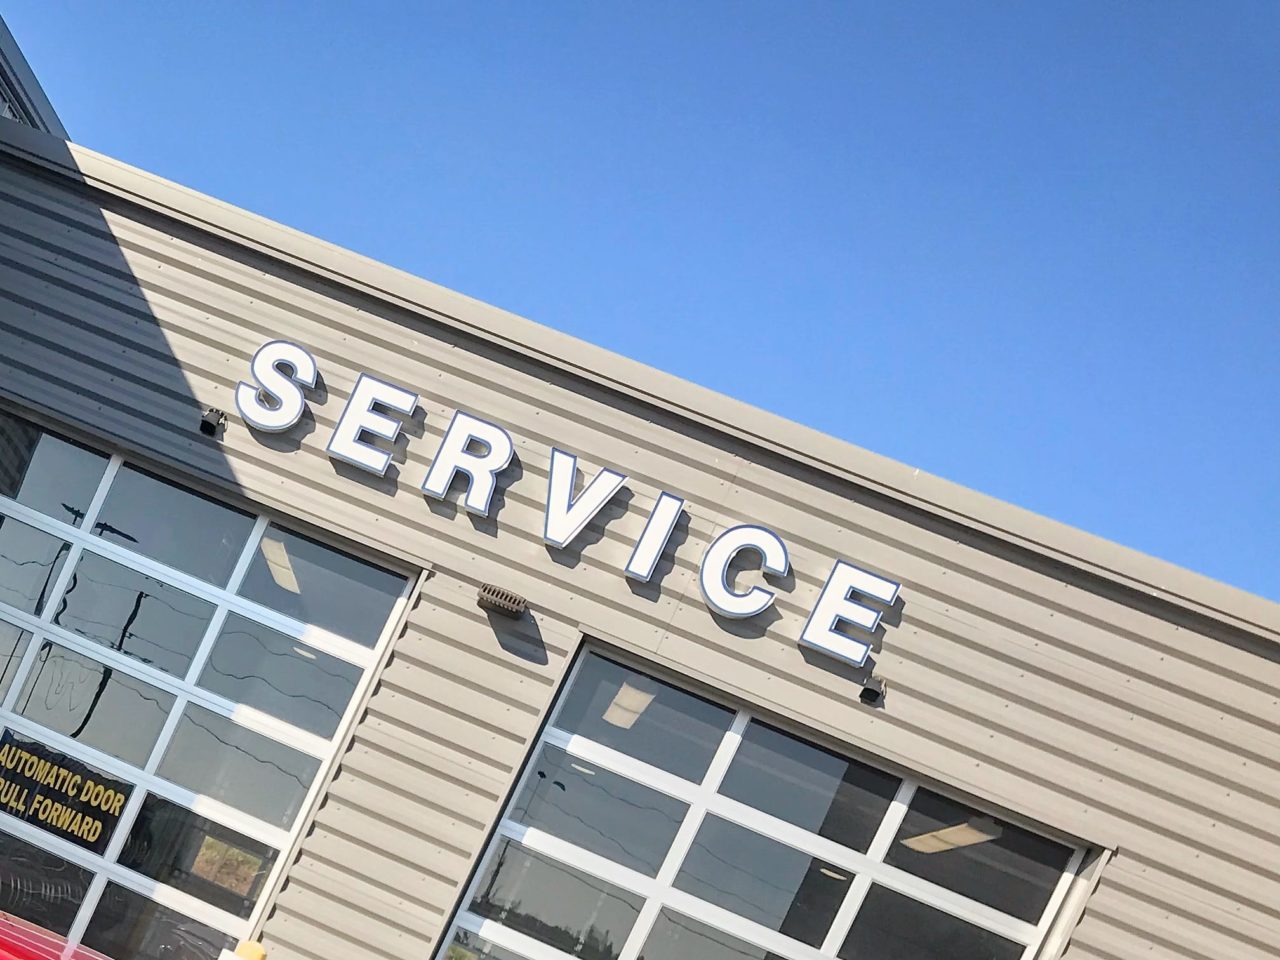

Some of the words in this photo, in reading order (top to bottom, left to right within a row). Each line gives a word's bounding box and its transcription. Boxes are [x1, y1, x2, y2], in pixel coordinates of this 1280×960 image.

[235, 340, 901, 668] SERVICE
[29, 794, 103, 843] FORWARD
[79, 780, 125, 817] DOOR
